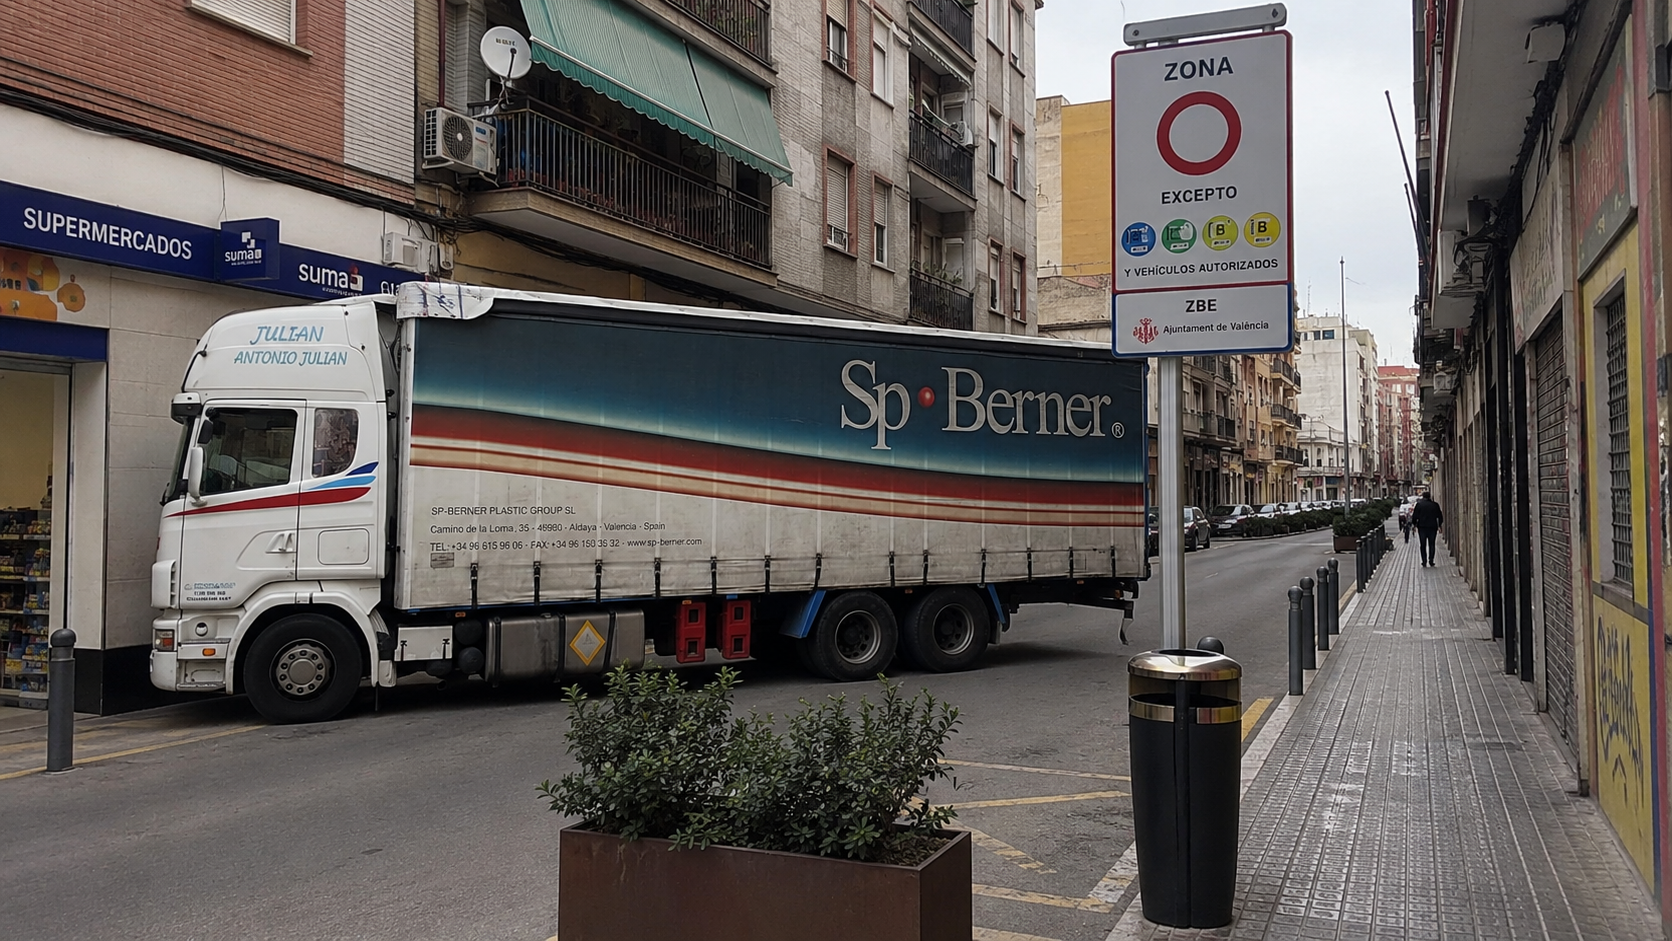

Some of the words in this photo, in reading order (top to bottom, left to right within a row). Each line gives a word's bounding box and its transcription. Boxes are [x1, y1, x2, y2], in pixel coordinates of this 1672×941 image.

[1164, 57, 1233, 81] ZONA
[1161, 186, 1237, 205] EXCEPTO
[23, 207, 192, 260] SUPERMERCADOS
[1216, 224, 1225, 236] B
[1258, 221, 1267, 233] B
[225, 249, 254, 262] suma
[298, 263, 349, 289] suma
[1124, 268, 1132, 278] Y
[1134, 265, 1195, 277] VEHÍCULOS
[1199, 259, 1278, 273] AUTORIZADOS
[1186, 299, 1217, 312] ZBE
[249, 325, 324, 346] JULIAN
[1163, 323, 1214, 335] Ajuntament
[1216, 323, 1227, 332] de
[233, 350, 298, 365] ANTONIO
[298, 351, 348, 367] JULIAN
[841, 359, 911, 450] Sp
[941, 366, 1113, 437] Berner
[431, 507, 487, 515] SP-BERNER
[489, 506, 528, 515] PLASTIC
[530, 506, 563, 515] GROUP
[564, 506, 576, 515] SL
[430, 525, 463, 534] Camino
[466, 525, 477, 533] de
[479, 525, 487, 533] la
[519, 524, 529, 532] 35
[569, 523, 597, 533] Aldaya
[604, 522, 637, 531] Valencia
[644, 522, 666, 531] Spain
[469, 542, 479, 550] 96
[482, 542, 498, 550] 615
[500, 541, 511, 550] 96
[513, 541, 523, 550] 06
[610, 539, 620, 547] 32
